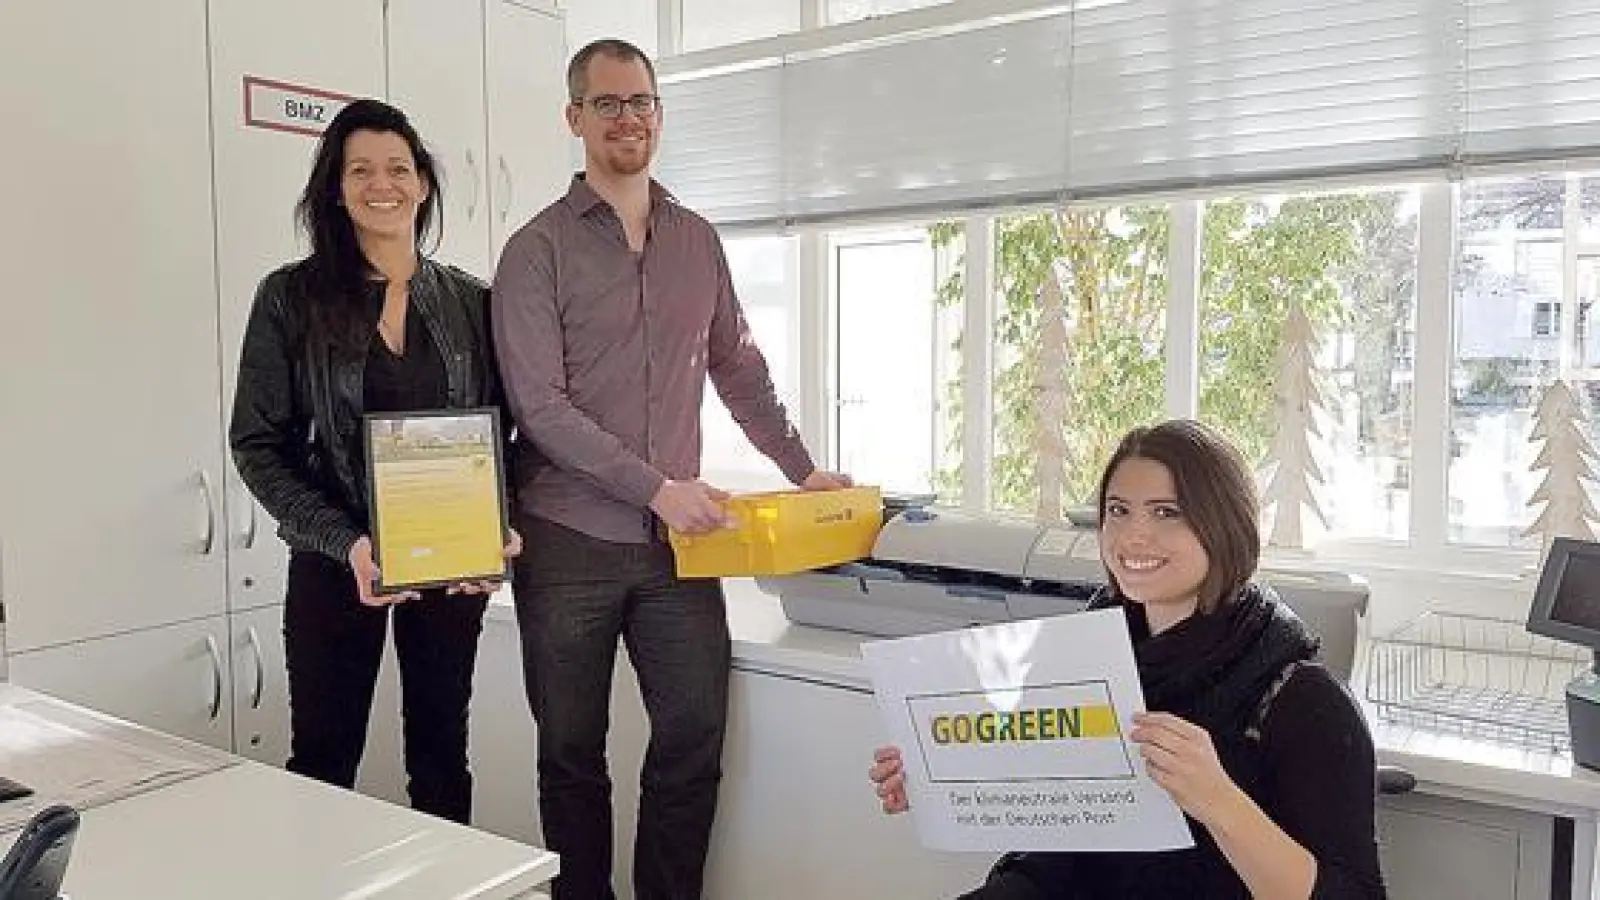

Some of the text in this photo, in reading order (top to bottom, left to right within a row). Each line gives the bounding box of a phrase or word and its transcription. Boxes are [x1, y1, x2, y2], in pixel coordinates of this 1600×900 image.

[285, 99, 326, 123] BMZ
[932, 708, 1081, 744] GOGREEN
[1071, 789, 1135, 804] Versand
[956, 809, 1116, 826] mit der Deutschen Post
